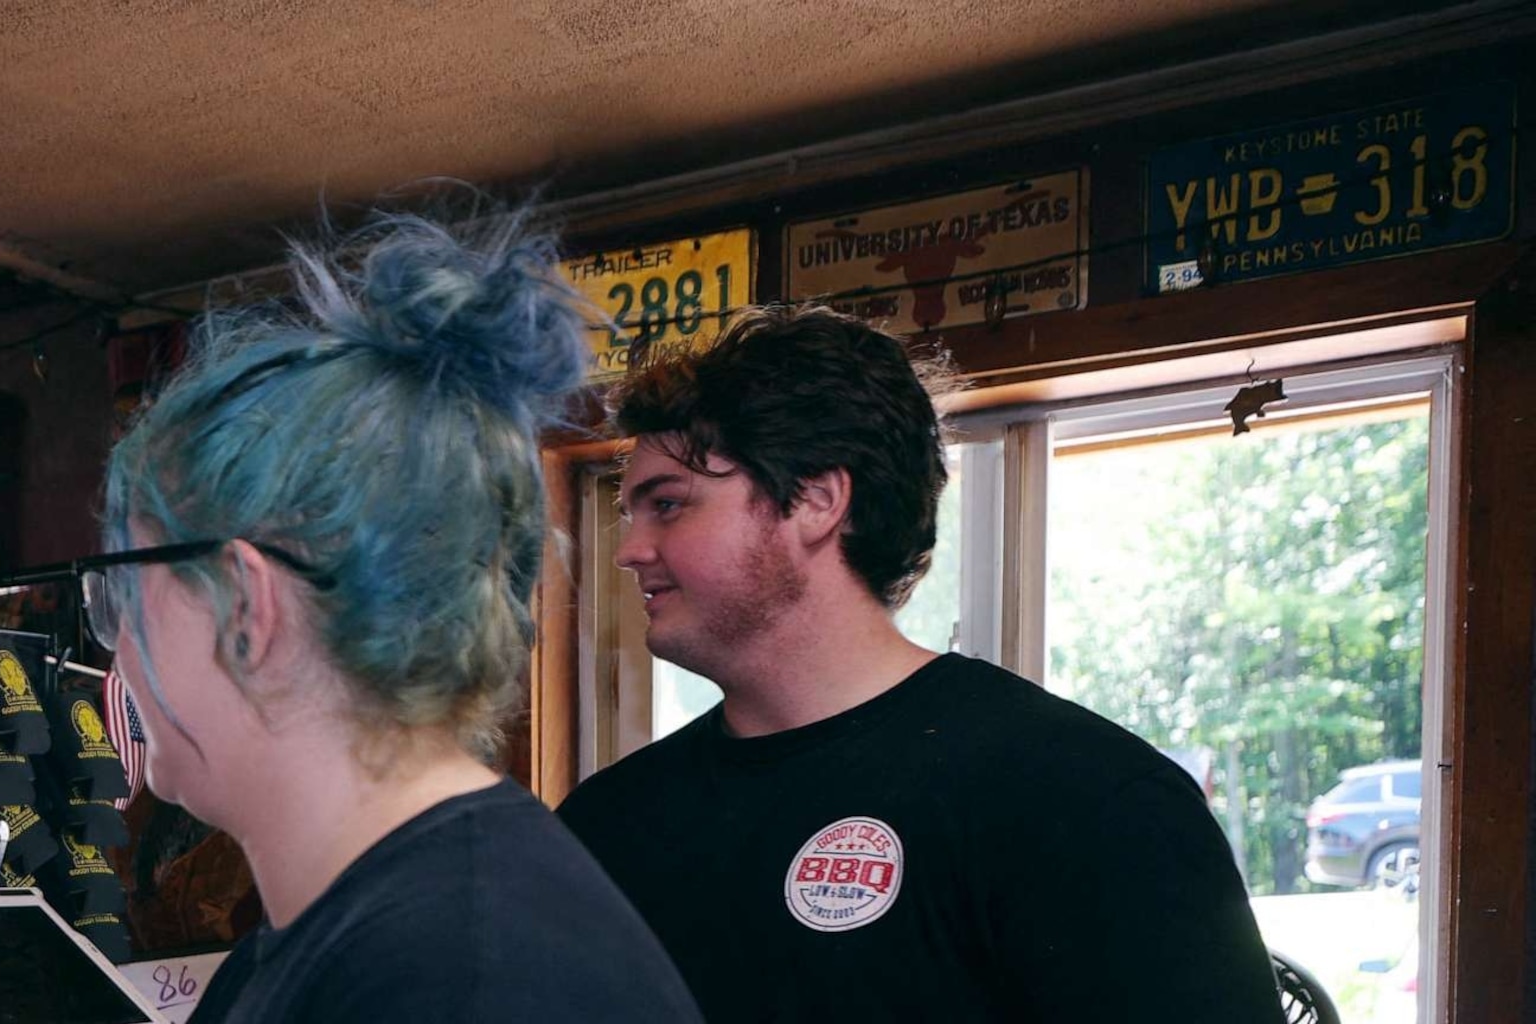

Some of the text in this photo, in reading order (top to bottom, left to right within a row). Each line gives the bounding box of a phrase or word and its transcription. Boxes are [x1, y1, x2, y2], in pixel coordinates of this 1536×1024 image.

[1224, 108, 1423, 163] KEYSTONE STATE
[1165, 125, 1489, 253] YWB 318
[798, 197, 1070, 269] UNIVERSITY OF TEXAS
[1223, 222, 1423, 275] PENNSYLVANIA
[568, 249, 673, 281] TRAILER
[606, 263, 733, 348] 2881
[816, 824, 857, 849] GOODY
[796, 857, 894, 894] BBQ
[152, 964, 197, 1002] 86
